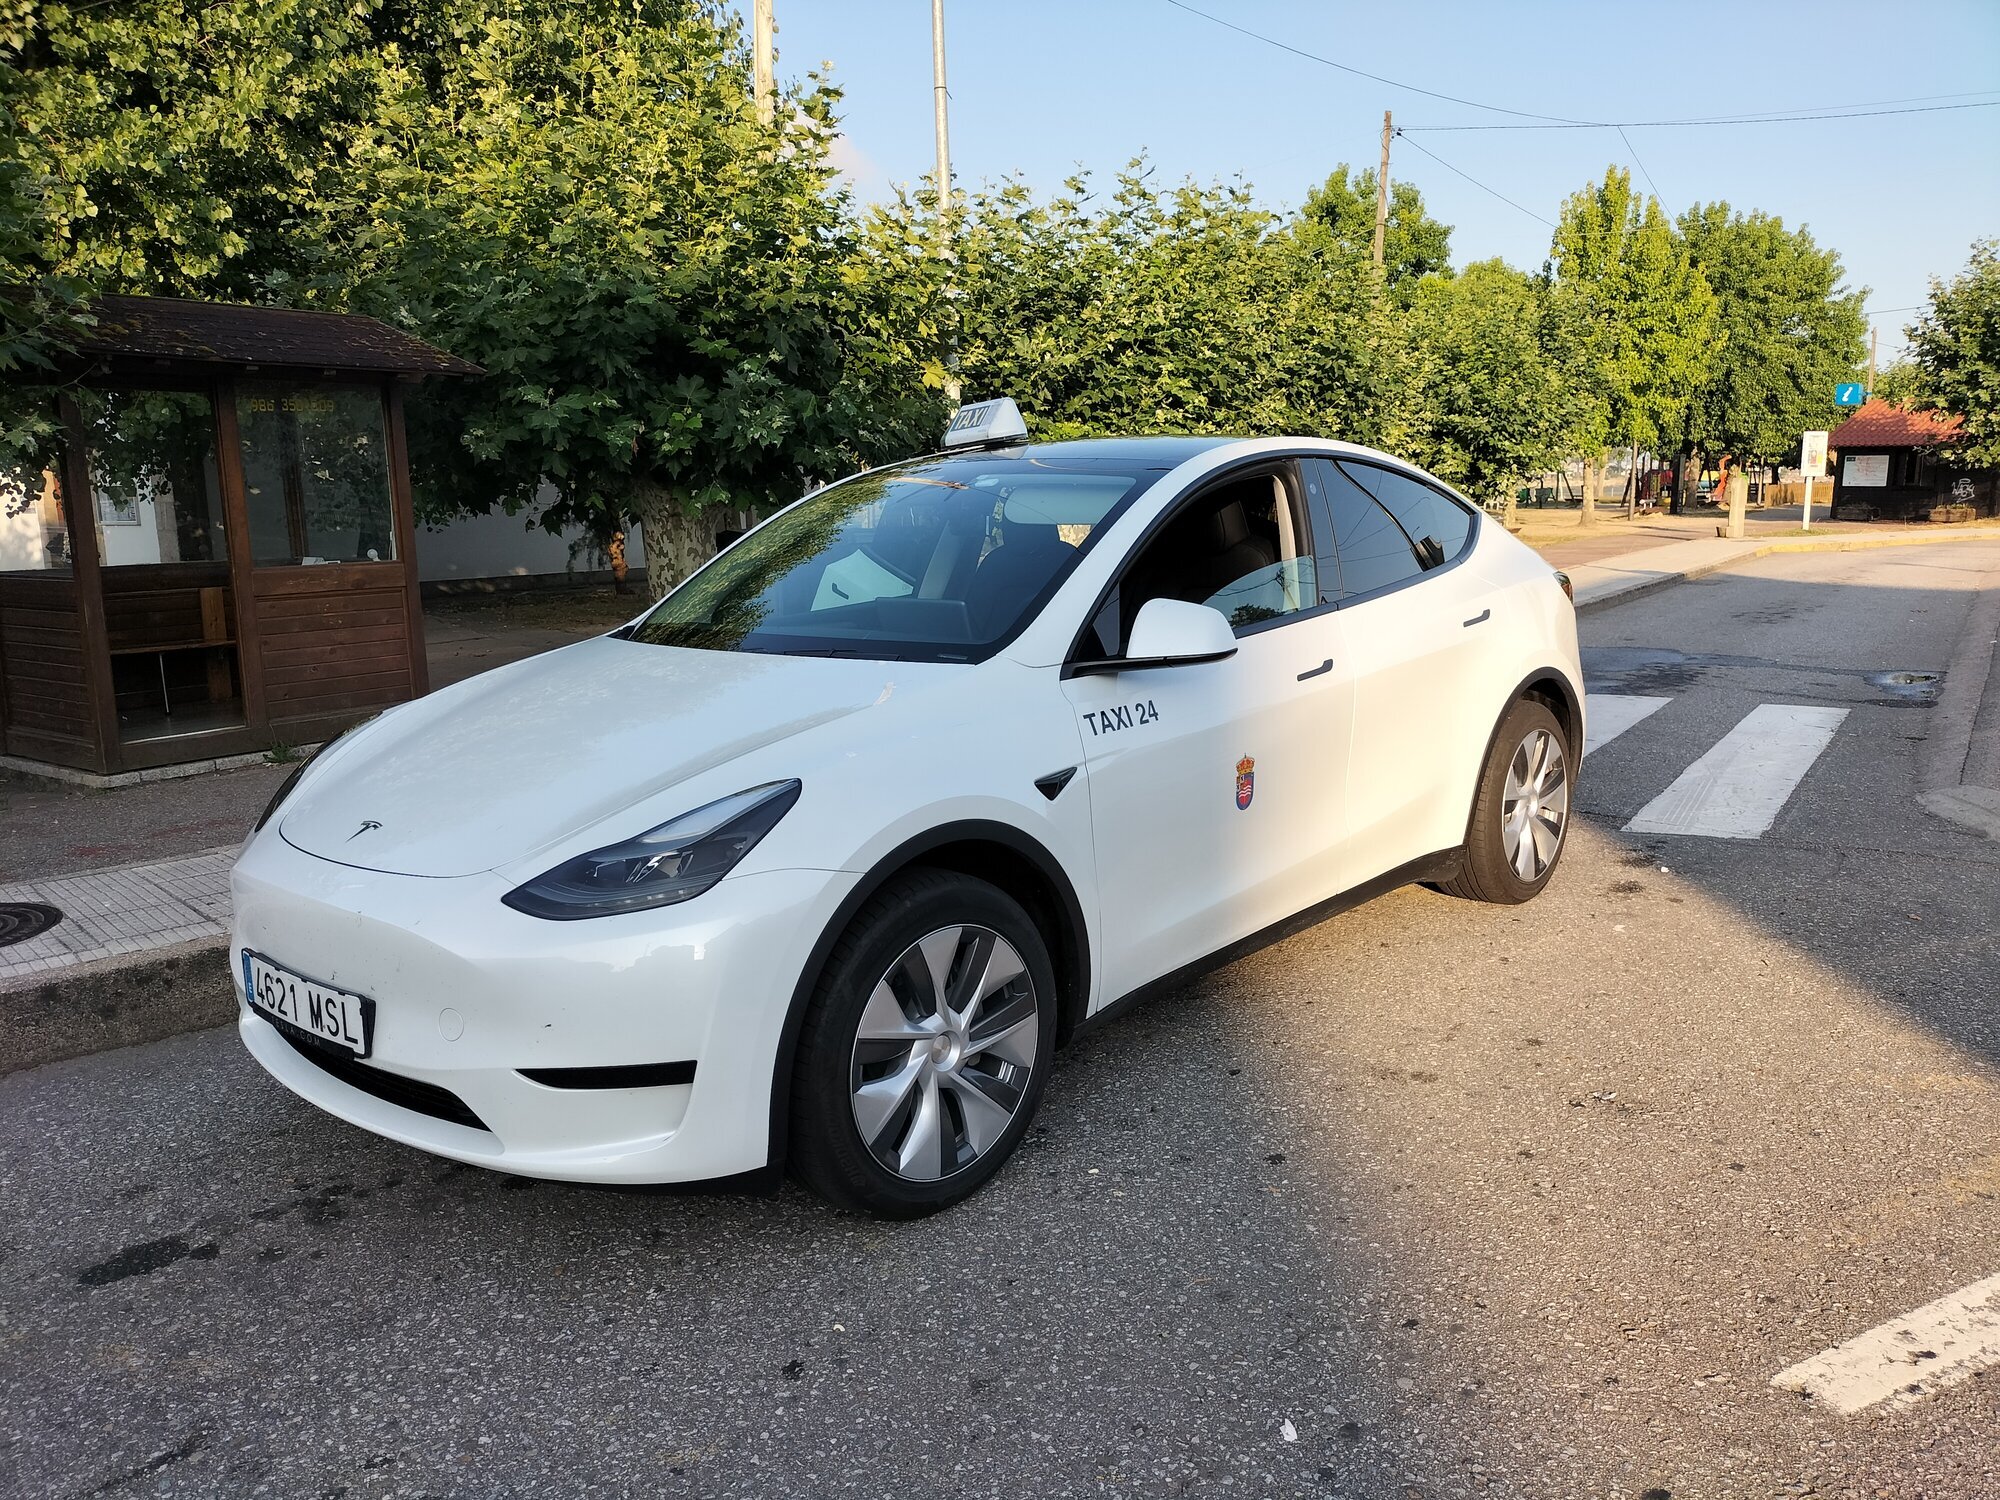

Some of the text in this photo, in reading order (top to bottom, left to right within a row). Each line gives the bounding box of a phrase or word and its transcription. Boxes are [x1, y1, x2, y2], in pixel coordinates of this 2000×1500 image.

[251, 399, 275, 412] 986
[954, 406, 989, 430] TAXI
[1082, 699, 1159, 736] TAXI 24
[256, 967, 359, 1045] 4621 MSL
